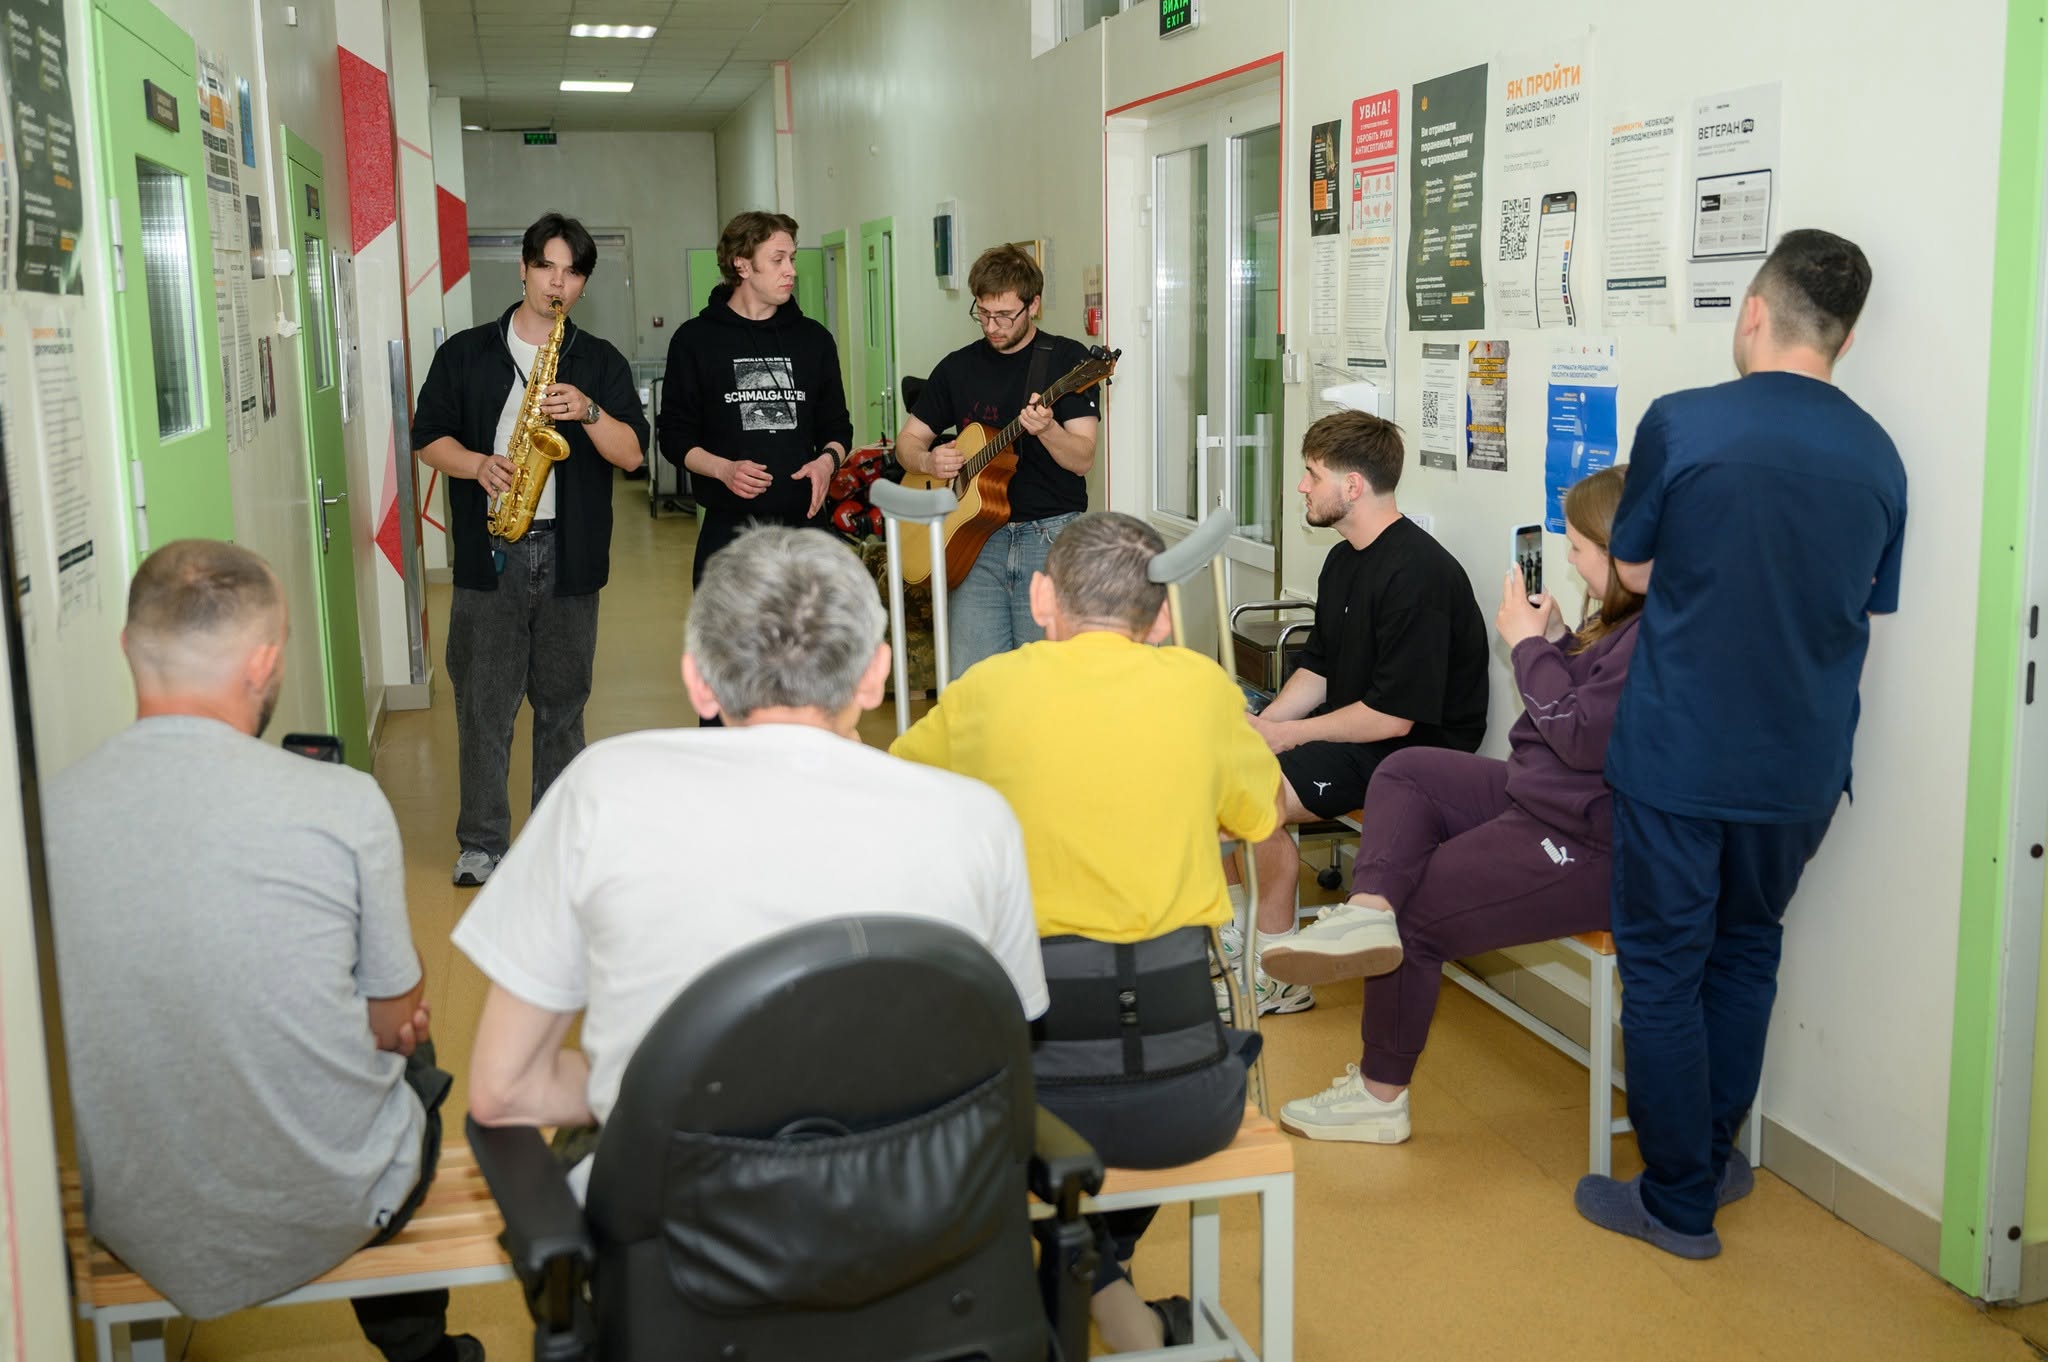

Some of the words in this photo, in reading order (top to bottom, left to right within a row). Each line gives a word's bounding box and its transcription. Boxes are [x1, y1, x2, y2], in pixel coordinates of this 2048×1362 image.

[1166, 11, 1184, 28] EXIT
[1507, 78, 1523, 100] ЯК
[1526, 63, 1581, 97] ПРОЙТИ
[1360, 99, 1391, 120] УВАГА!
[1505, 92, 1580, 117] ВІЙСЬКОВО-ЛІКАРСЬКУ
[1505, 119, 1533, 133] КОМІСІЮ
[1698, 120, 1741, 141] ВЕТЕРАН
